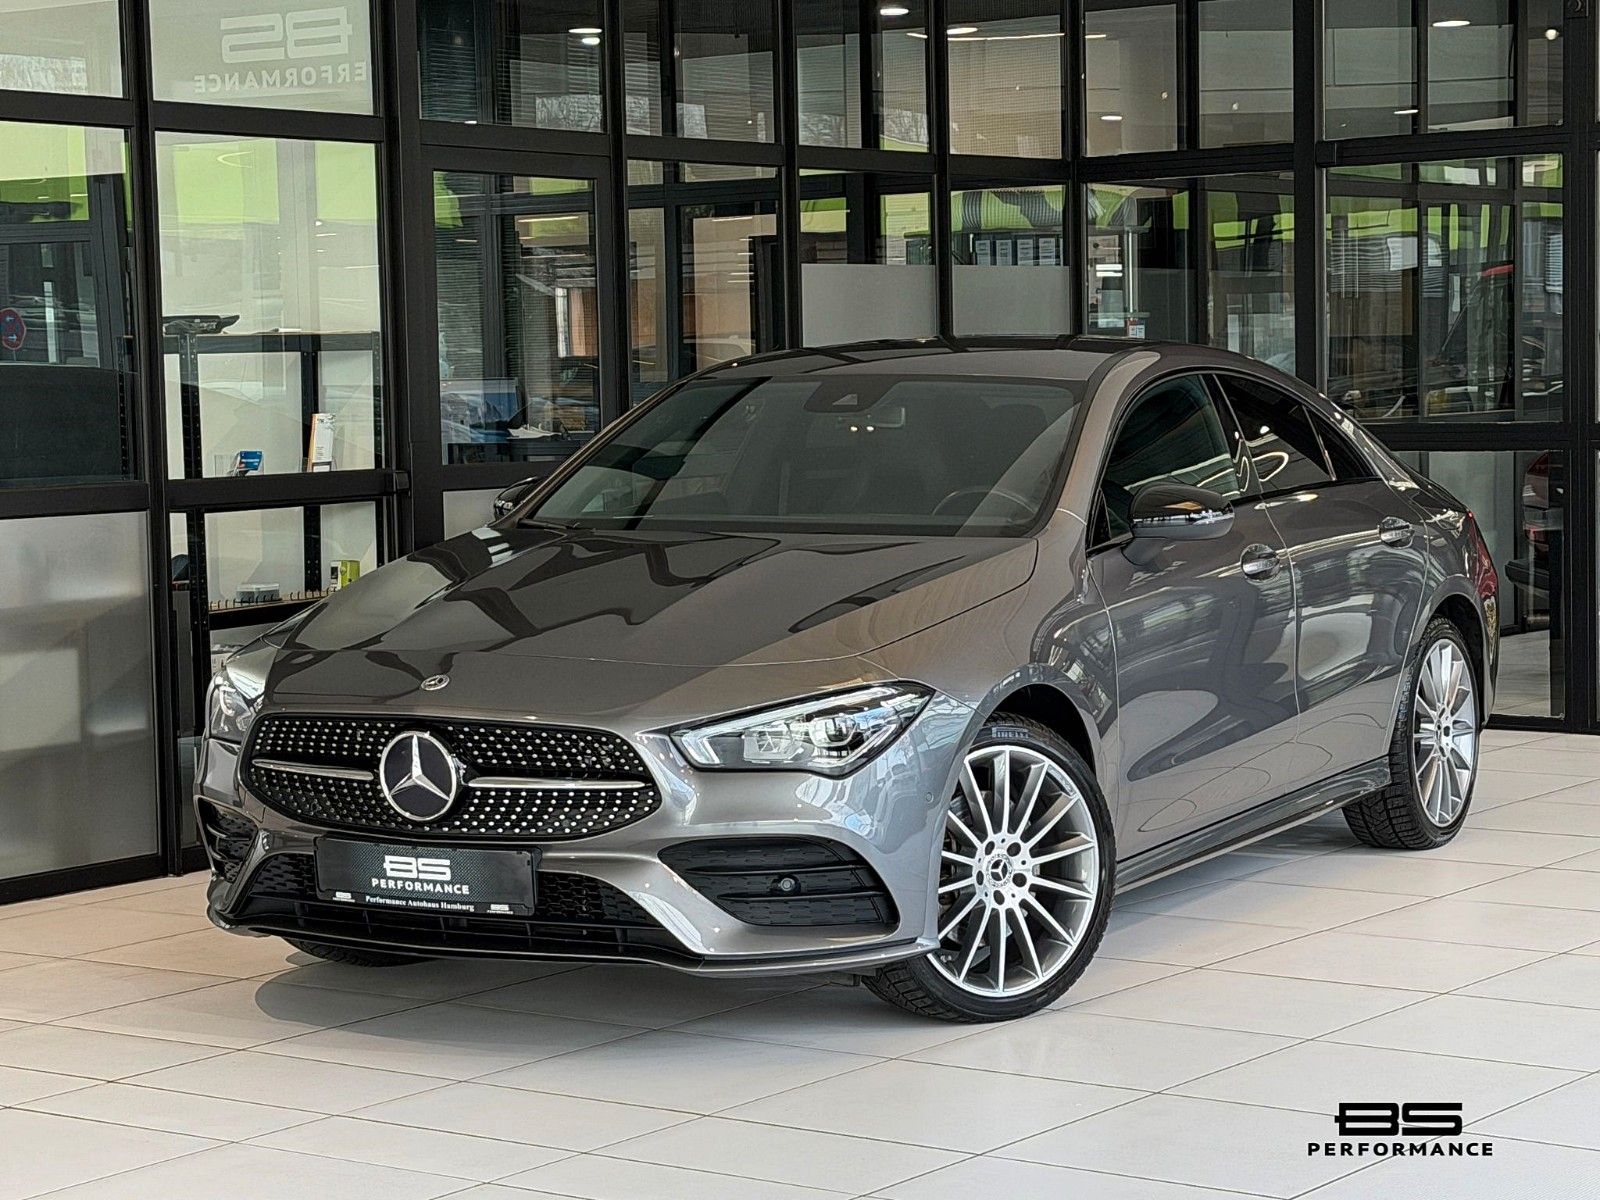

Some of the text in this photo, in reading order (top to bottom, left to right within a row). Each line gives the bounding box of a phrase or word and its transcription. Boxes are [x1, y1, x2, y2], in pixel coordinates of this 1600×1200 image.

[384, 855, 451, 881] BS
[371, 878, 470, 895] PERFORMANCE
[365, 895, 406, 906] Performance
[408, 899, 439, 909] Autohaus
[440, 902, 475, 912] Hamburg
